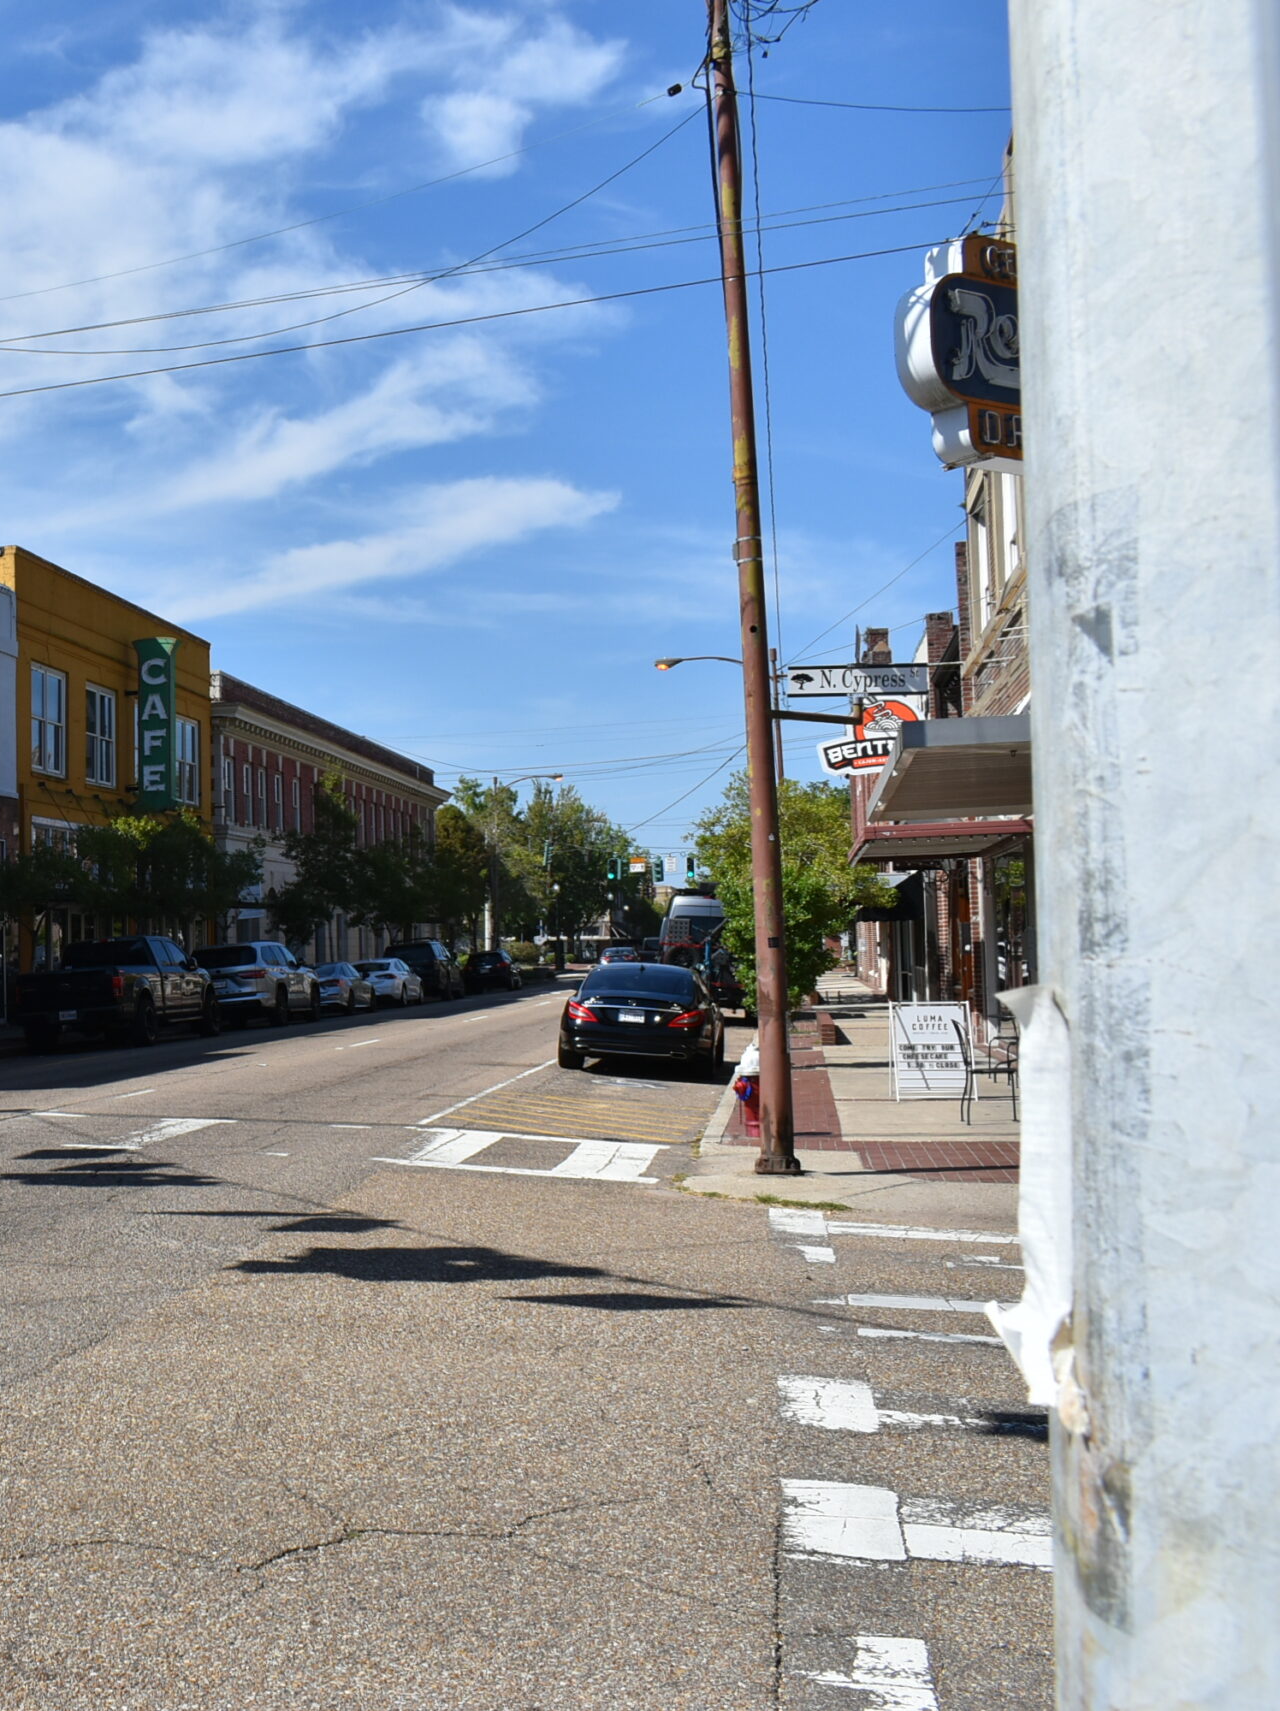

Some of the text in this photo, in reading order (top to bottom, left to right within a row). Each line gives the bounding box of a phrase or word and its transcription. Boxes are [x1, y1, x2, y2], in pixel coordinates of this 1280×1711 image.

[820, 668, 919, 693] N. Cypress St
[141, 657, 169, 792] CAFE
[916, 1015, 943, 1023] LUMA
[912, 1023, 948, 1031] COFFEE
[922, 1044, 936, 1052] TRY
